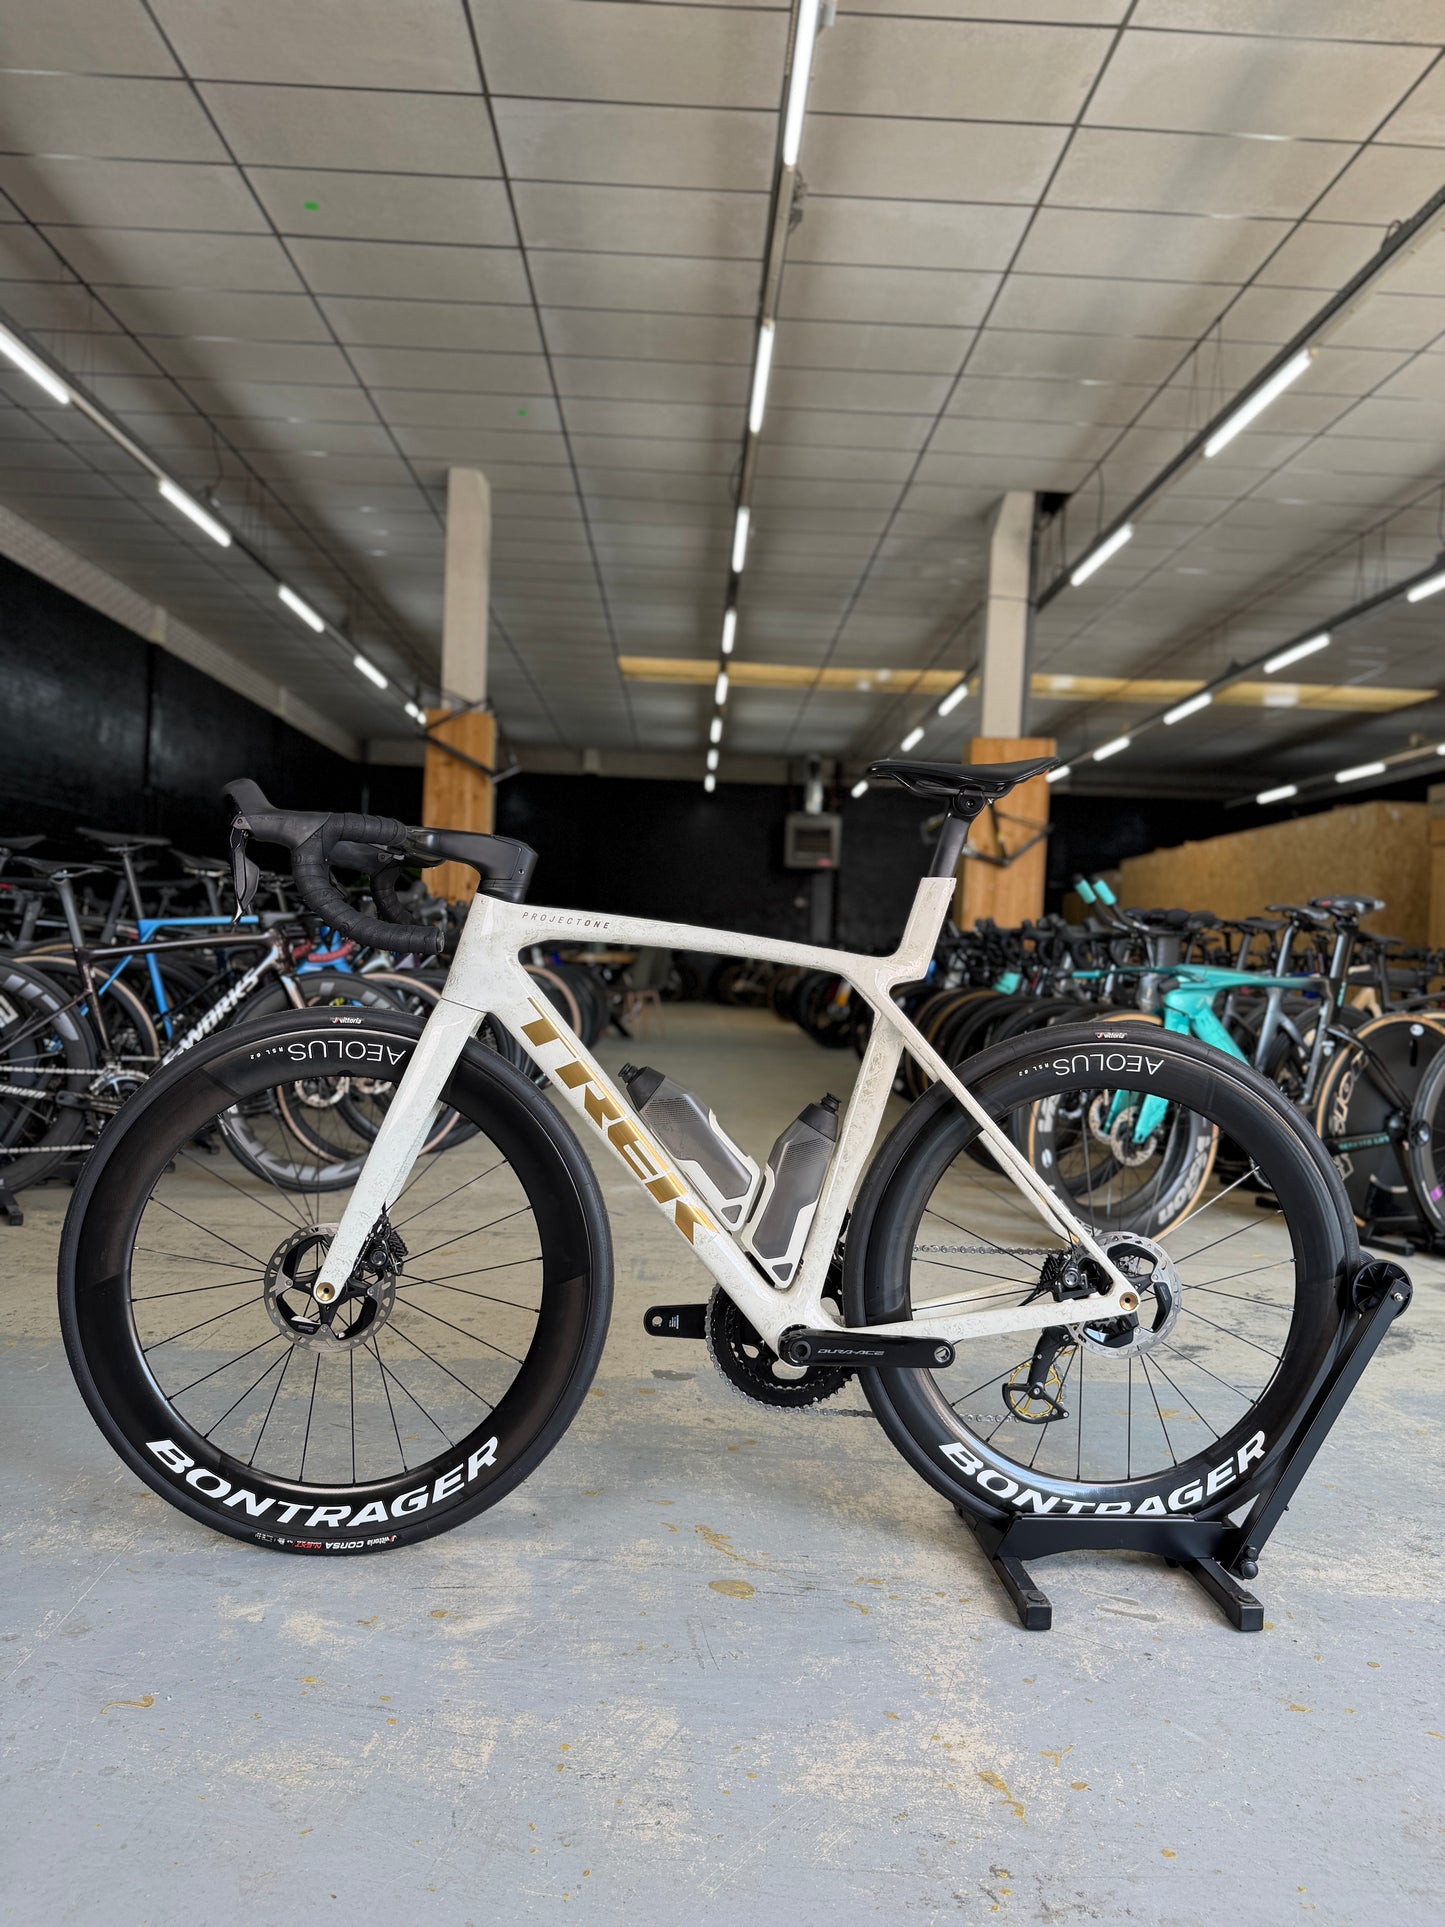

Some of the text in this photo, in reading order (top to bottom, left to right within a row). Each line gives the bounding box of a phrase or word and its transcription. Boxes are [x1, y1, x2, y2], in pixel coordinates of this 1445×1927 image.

[287, 1040, 406, 1066] AEOLUS
[1052, 1053, 1165, 1076] AEOLUS
[520, 997, 721, 1245] TREK
[817, 1348, 886, 1356] DURA-ACE
[145, 1436, 499, 1528] BONTRAGER
[938, 1430, 1266, 1514] BONTRAGER
[325, 1540, 364, 1550] CORSA
[365, 1536, 390, 1547] vittoria
